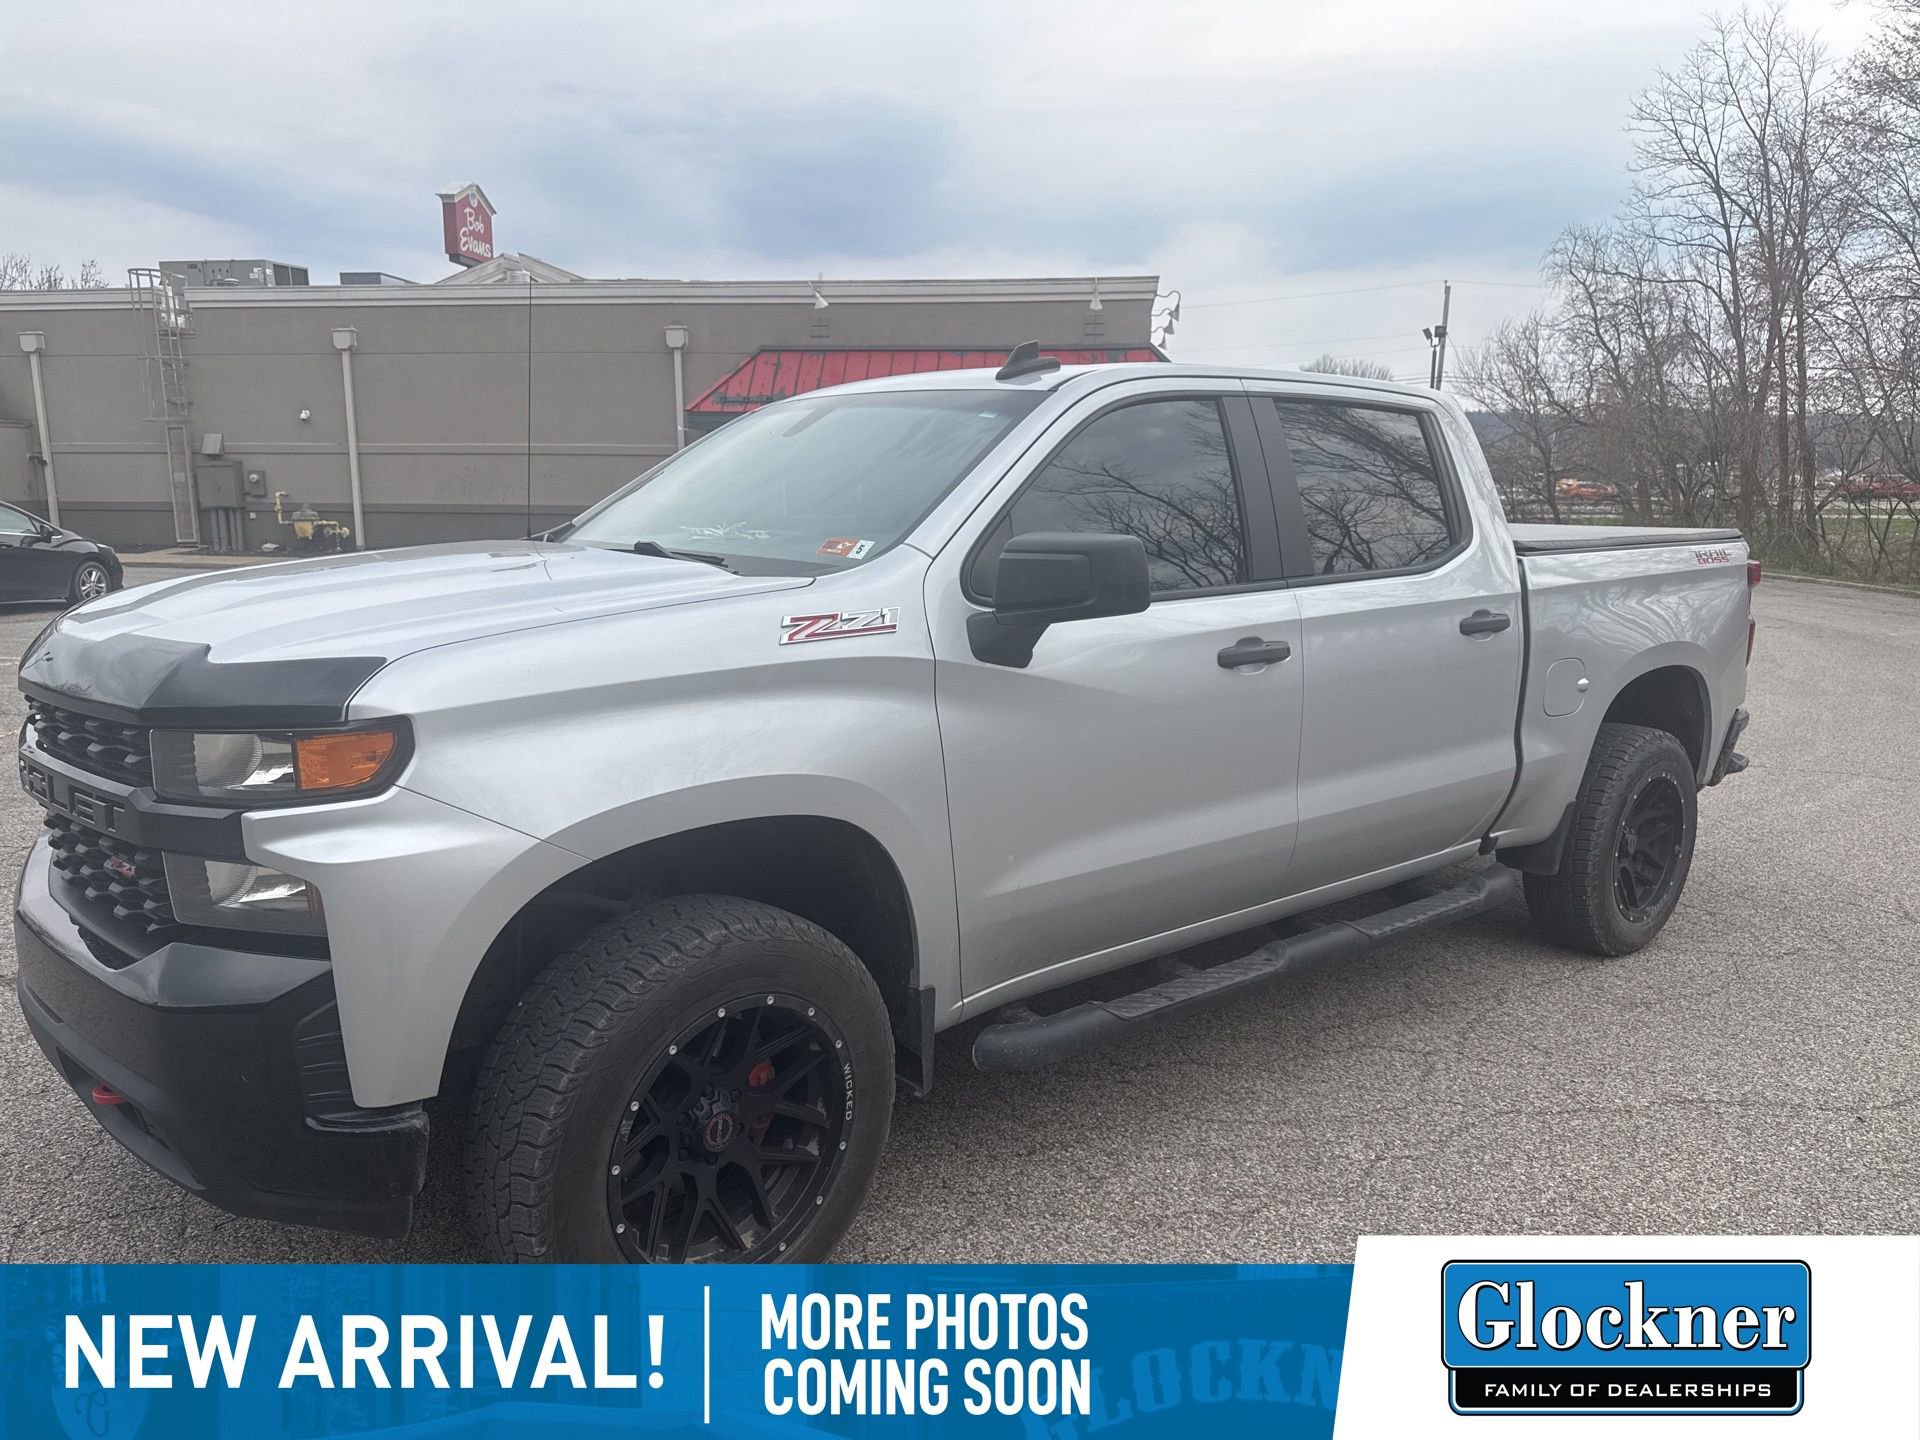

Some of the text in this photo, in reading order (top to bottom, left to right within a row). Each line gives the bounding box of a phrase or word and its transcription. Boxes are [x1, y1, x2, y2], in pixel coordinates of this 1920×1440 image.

[464, 207, 484, 234] Bob
[460, 227, 491, 258] Evans
[1689, 548, 1732, 558] TRAIL
[1696, 555, 1729, 565] BOSS
[779, 606, 900, 646] Z71
[844, 1062, 853, 1121] WICKED
